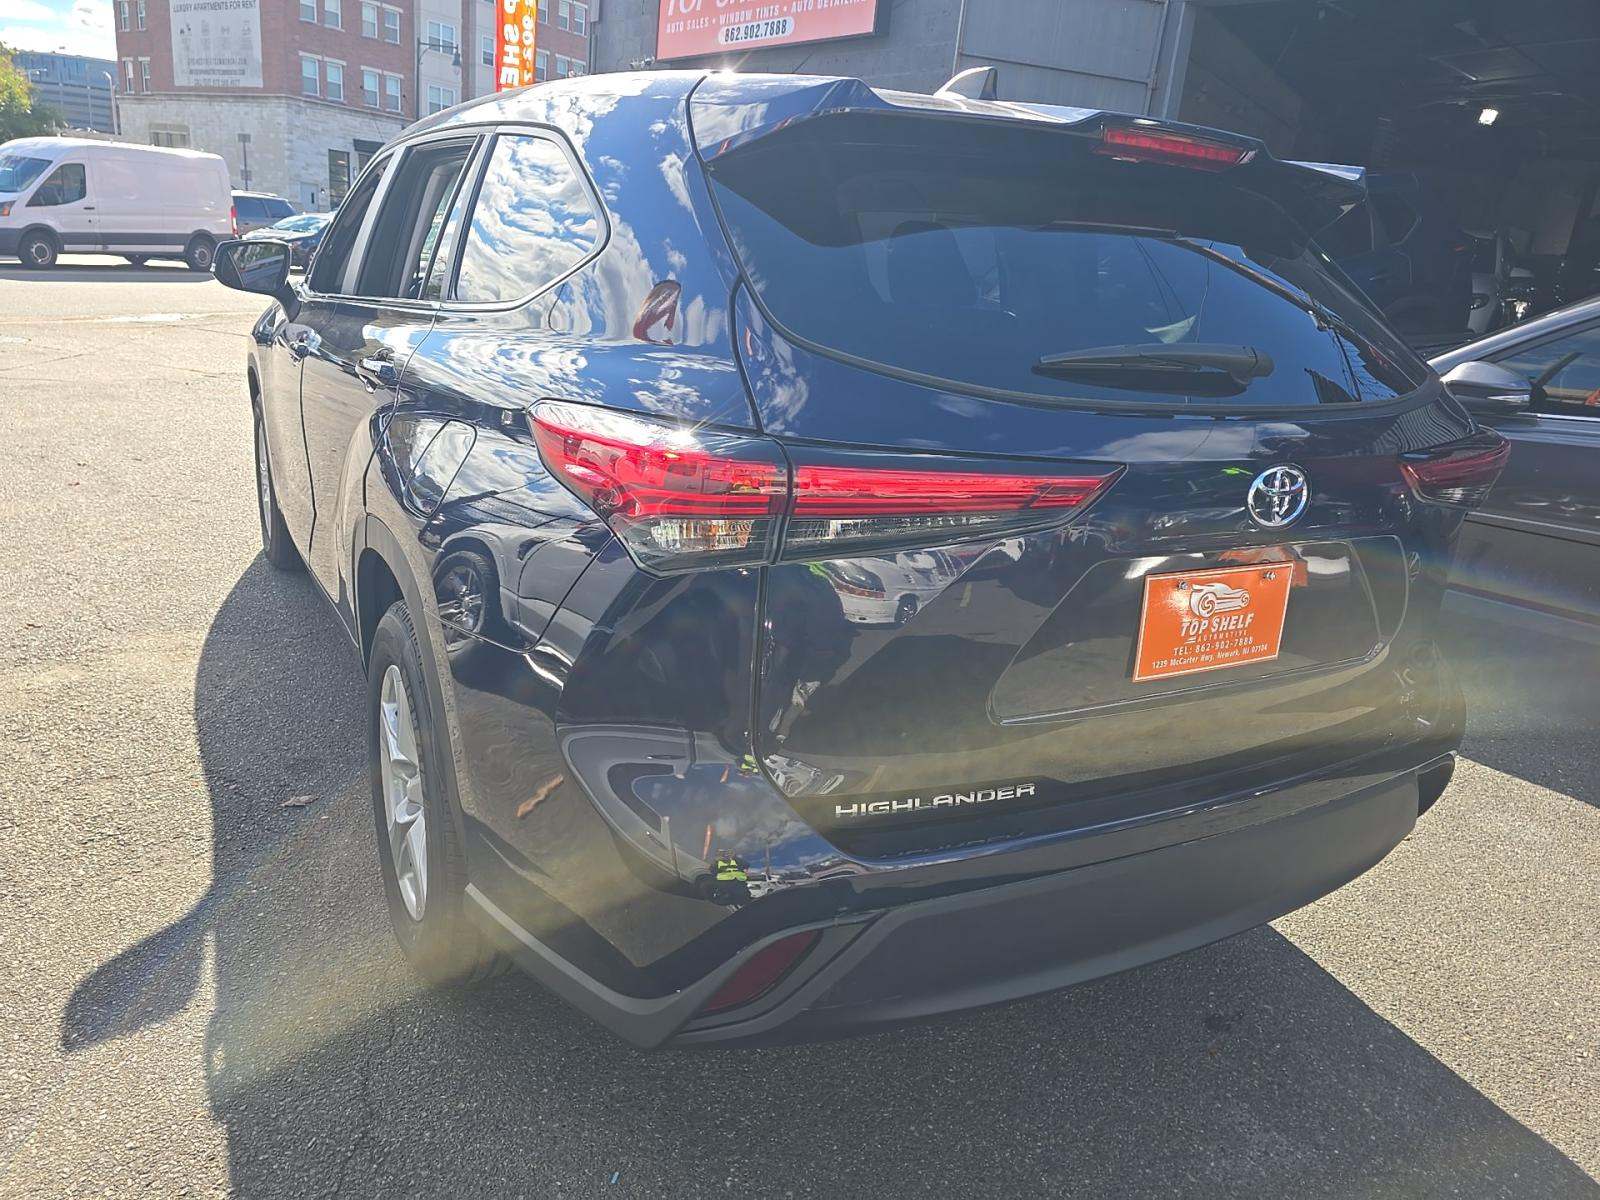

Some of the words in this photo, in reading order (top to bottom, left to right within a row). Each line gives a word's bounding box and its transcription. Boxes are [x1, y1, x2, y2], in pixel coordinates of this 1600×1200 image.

[230, 0, 240, 9] FOR
[666, 22, 684, 33] AUTO
[687, 16, 709, 31] SALES
[720, 9, 753, 26] WINDOW
[755, 5, 779, 19] TINTS
[791, 0, 813, 14] AUTO
[724, 19, 787, 42] 862.902.7888
[1180, 619, 1209, 637] TOP
[1211, 612, 1254, 632] SHELF
[1173, 645, 1193, 656] TEL:
[1195, 636, 1253, 653] 862-902-7888
[1152, 659, 1168, 669] 1239
[1170, 656, 1199, 667] McCarter
[835, 783, 1036, 818] HIGHLANDER
